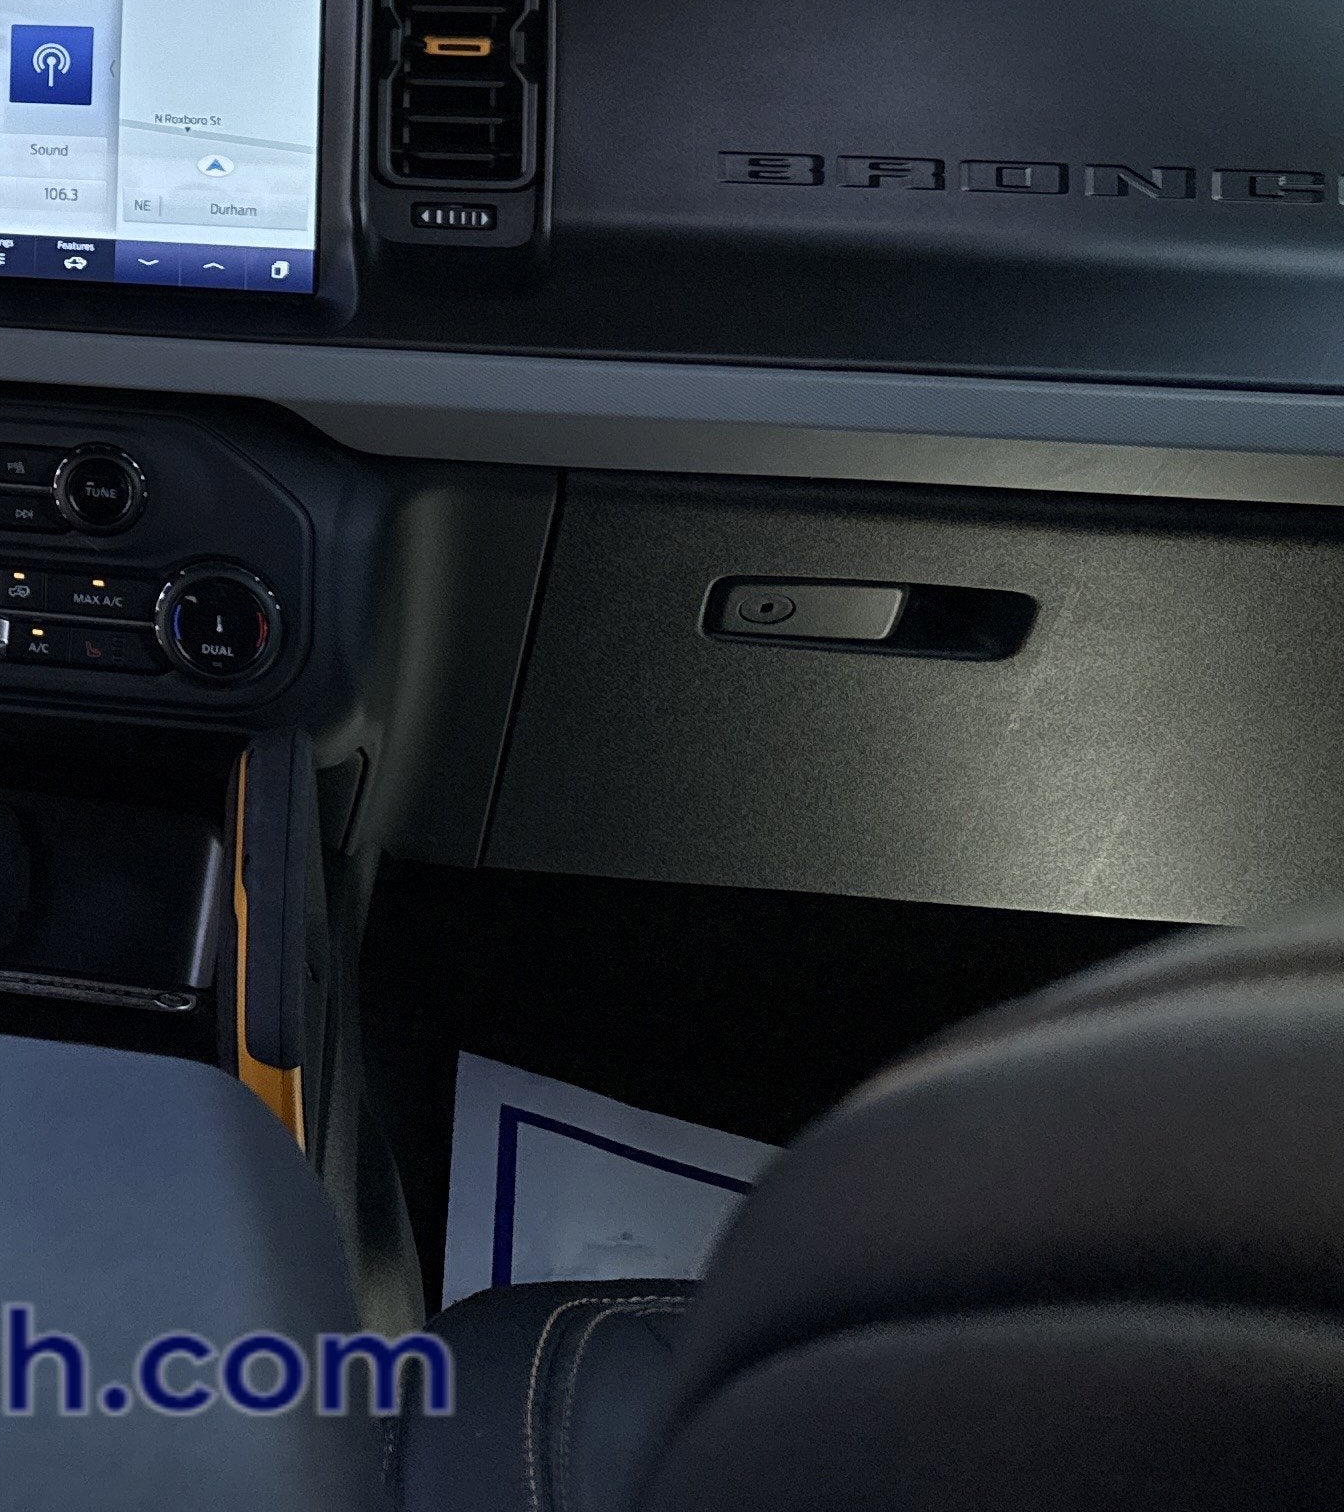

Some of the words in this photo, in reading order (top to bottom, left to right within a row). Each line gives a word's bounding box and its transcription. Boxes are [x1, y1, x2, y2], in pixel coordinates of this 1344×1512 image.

[155, 113, 163, 123] N
[165, 114, 208, 126] Roxboro
[210, 116, 222, 126] St
[29, 143, 69, 157] Sound
[717, 150, 1344, 206] BRONC
[44, 187, 79, 202] 106.3
[133, 200, 151, 212] NE
[210, 203, 258, 217] Durham
[56, 240, 95, 252] Features
[85, 486, 116, 499] TUNE
[73, 593, 100, 606] MAX
[102, 596, 123, 608] A/C
[28, 643, 50, 654] A/C
[201, 644, 234, 657] DUAL
